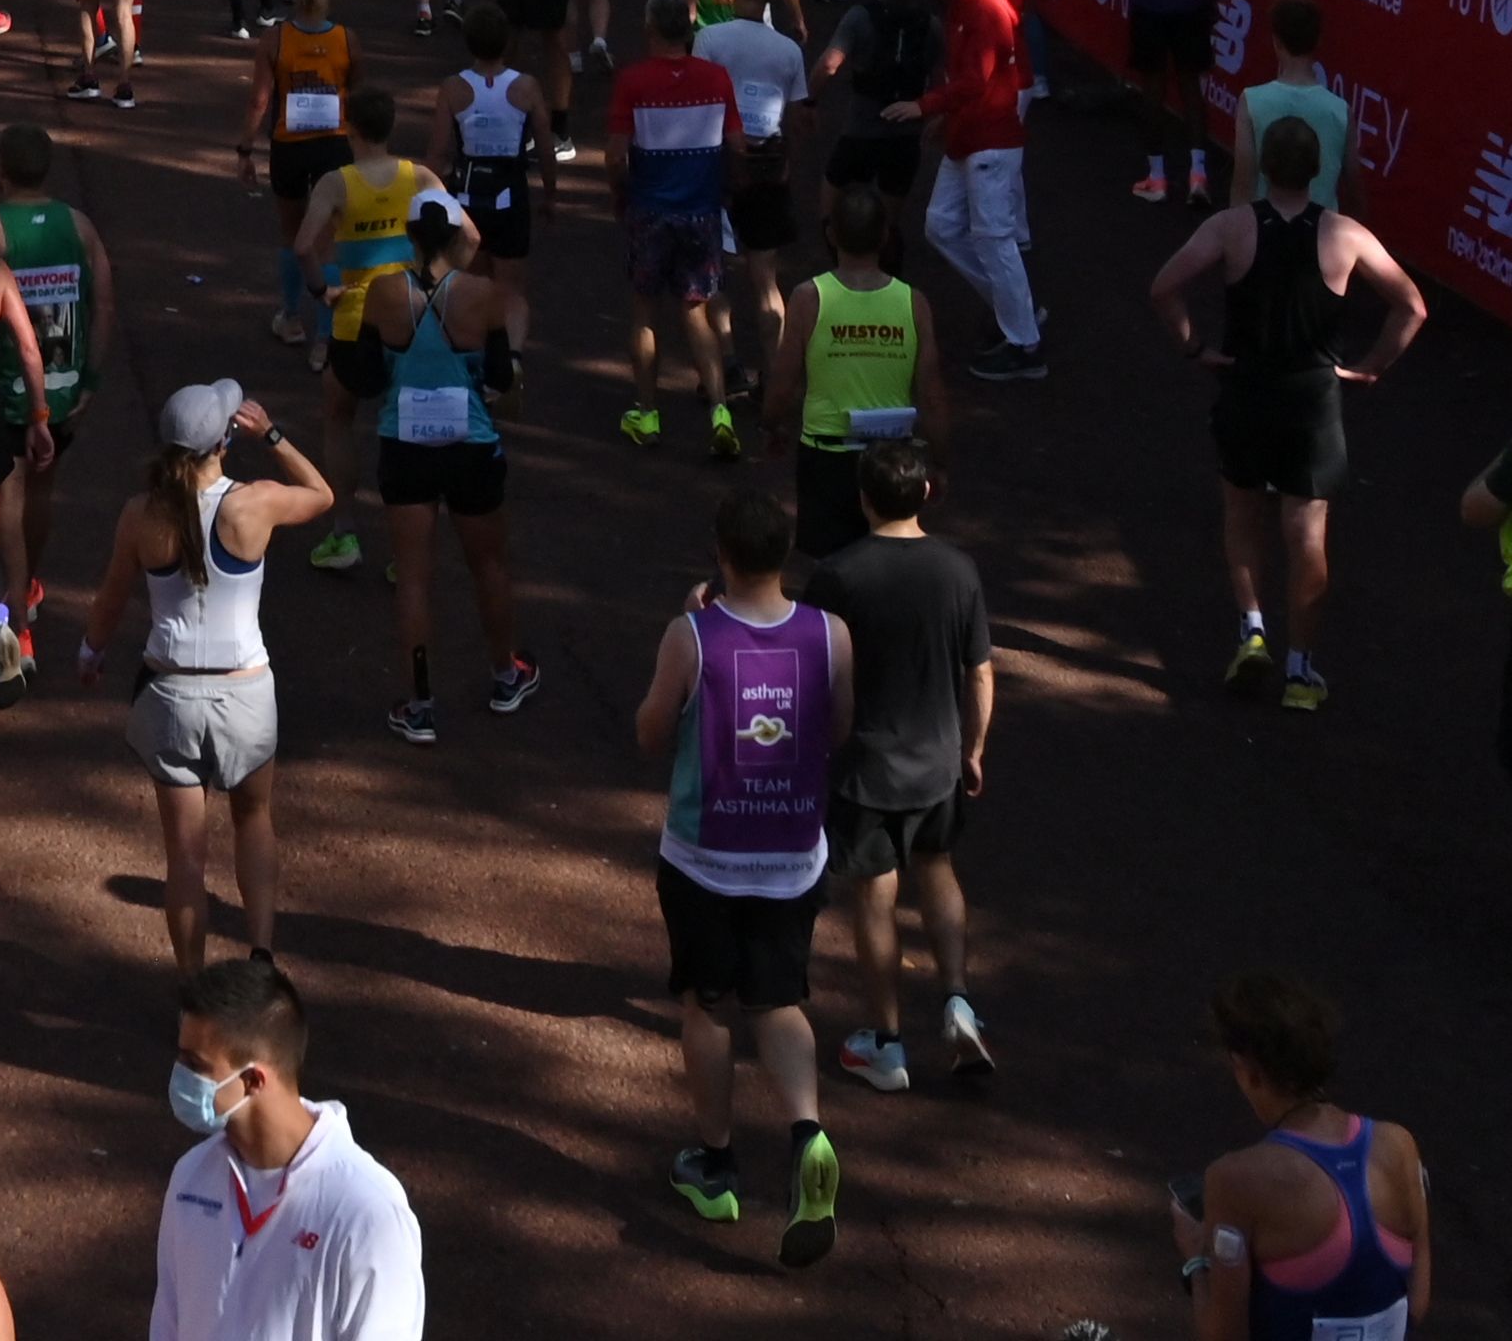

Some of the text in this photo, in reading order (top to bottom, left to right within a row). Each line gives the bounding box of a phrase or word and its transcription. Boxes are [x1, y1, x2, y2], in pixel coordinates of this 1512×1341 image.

[354, 218, 397, 233] WEST
[1446, 223, 1475, 259] new
[830, 324, 905, 340] WESTON
[742, 682, 793, 701] asthma
[776, 699, 792, 710] UK
[743, 778, 791, 794] TEAM
[713, 796, 816, 814] ASTHMA UK
